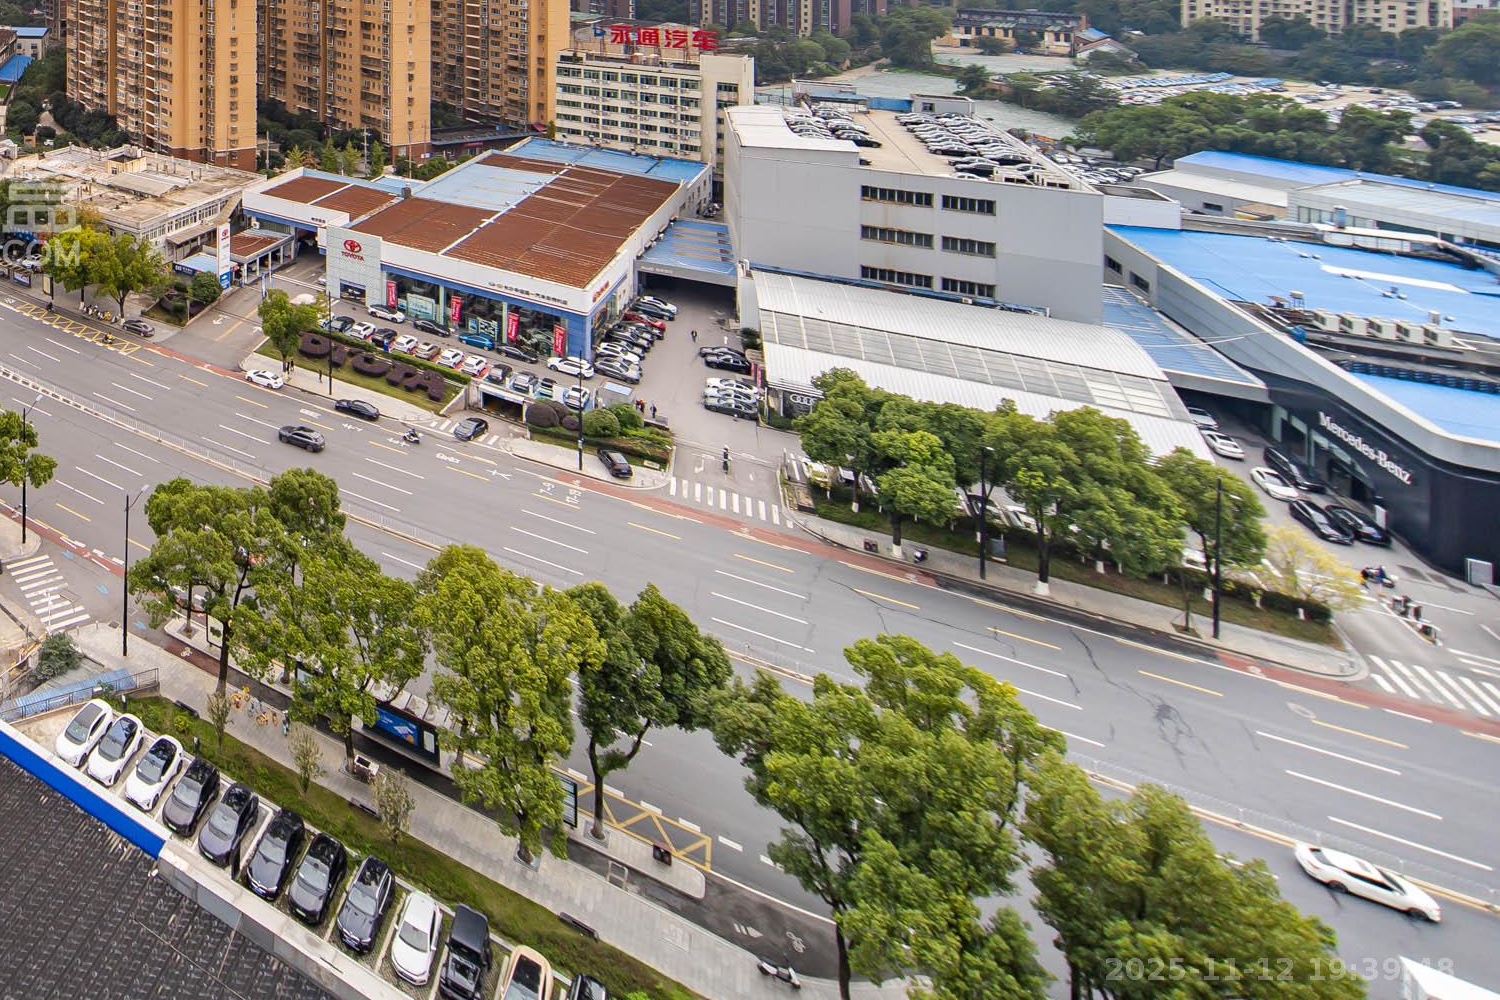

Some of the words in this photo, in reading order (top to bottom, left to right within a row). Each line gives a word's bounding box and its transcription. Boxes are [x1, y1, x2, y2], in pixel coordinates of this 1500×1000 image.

[611, 24, 717, 50] 永通汽车
[341, 251, 365, 262] TOYOTA
[1319, 411, 1412, 485] Mercedes-Benz
